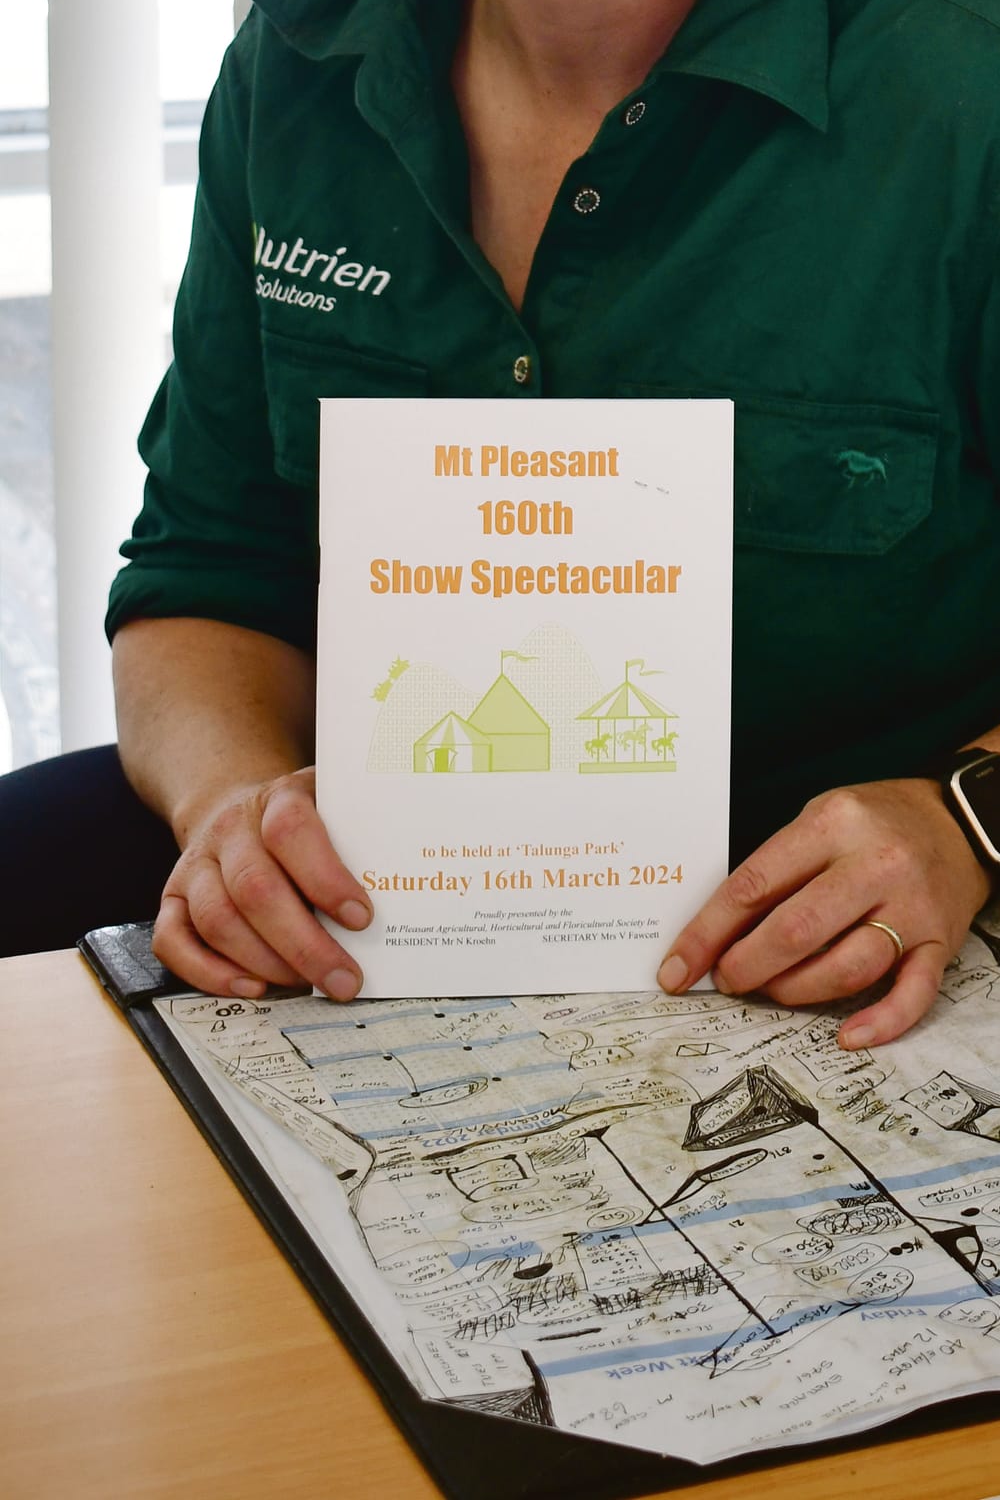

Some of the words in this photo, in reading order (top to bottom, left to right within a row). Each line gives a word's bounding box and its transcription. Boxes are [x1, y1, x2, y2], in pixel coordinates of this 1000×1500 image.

[255, 273, 337, 312] Solutions
[434, 445, 473, 477] Mt
[480, 445, 619, 477] Pleasant
[477, 501, 573, 535] 160th
[369, 559, 462, 595] Show
[471, 560, 682, 598] Spectacular
[422, 846, 436, 858] to
[441, 846, 457, 858] be
[462, 846, 492, 857] held
[497, 846, 510, 857] at
[361, 870, 472, 896] Saturday
[483, 869, 532, 890] 16th
[543, 867, 621, 889] March
[628, 864, 684, 885] 2024
[474, 911, 505, 920] Proudly
[507, 910, 547, 920] presented
[548, 909, 558, 918] by
[560, 908, 573, 916] the
[386, 924, 397, 933] Mt
[399, 925, 434, 933] Pleasant
[490, 922, 543, 931] Horticultural
[546, 922, 560, 930] and
[563, 920, 614, 929] Floricultural
[616, 919, 644, 927] Society
[647, 918, 659, 926] Inc
[385, 938, 439, 946] PRESIDENT
[441, 938, 453, 946] Mr
[542, 933, 598, 943] SECRETARY
[628, 931, 659, 940] Fawcett
[476, 1114, 566, 1138] Calendar
[422, 1134, 471, 1149] 2022
[860, 1270, 888, 1288] SUE
[788, 1304, 833, 1333] JASON
[859, 1306, 928, 1324] Friday
[605, 1360, 675, 1380] Week
